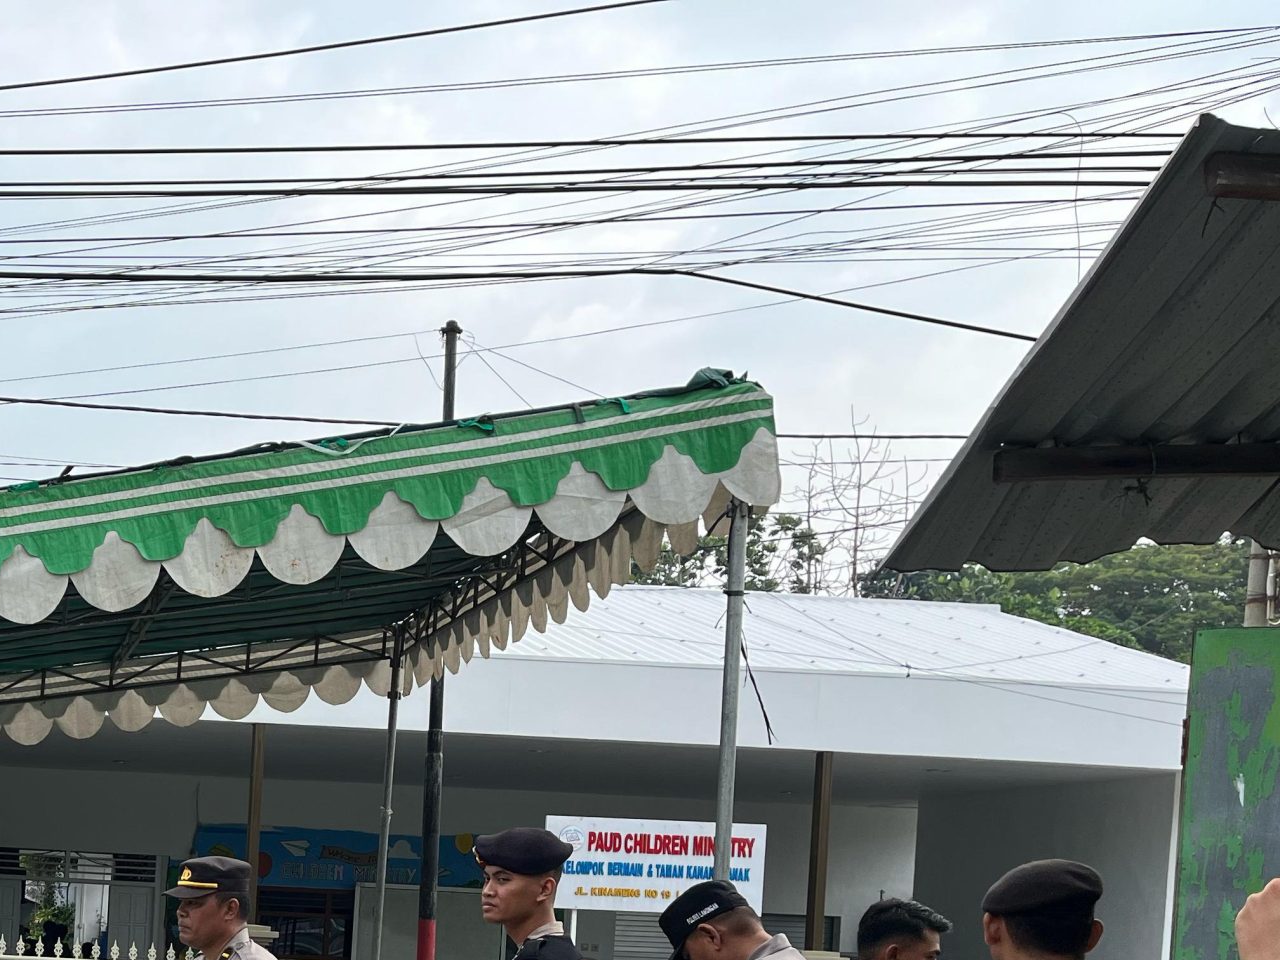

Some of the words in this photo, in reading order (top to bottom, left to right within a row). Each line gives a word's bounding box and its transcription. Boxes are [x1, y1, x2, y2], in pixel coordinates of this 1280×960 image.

[587, 831, 622, 853] PAUD
[624, 832, 689, 856] CHILDREN
[692, 835, 756, 858] MINTRY
[607, 862, 644, 877] BERMAIN
[656, 864, 684, 878] TAMAN
[645, 888, 658, 898] NO
